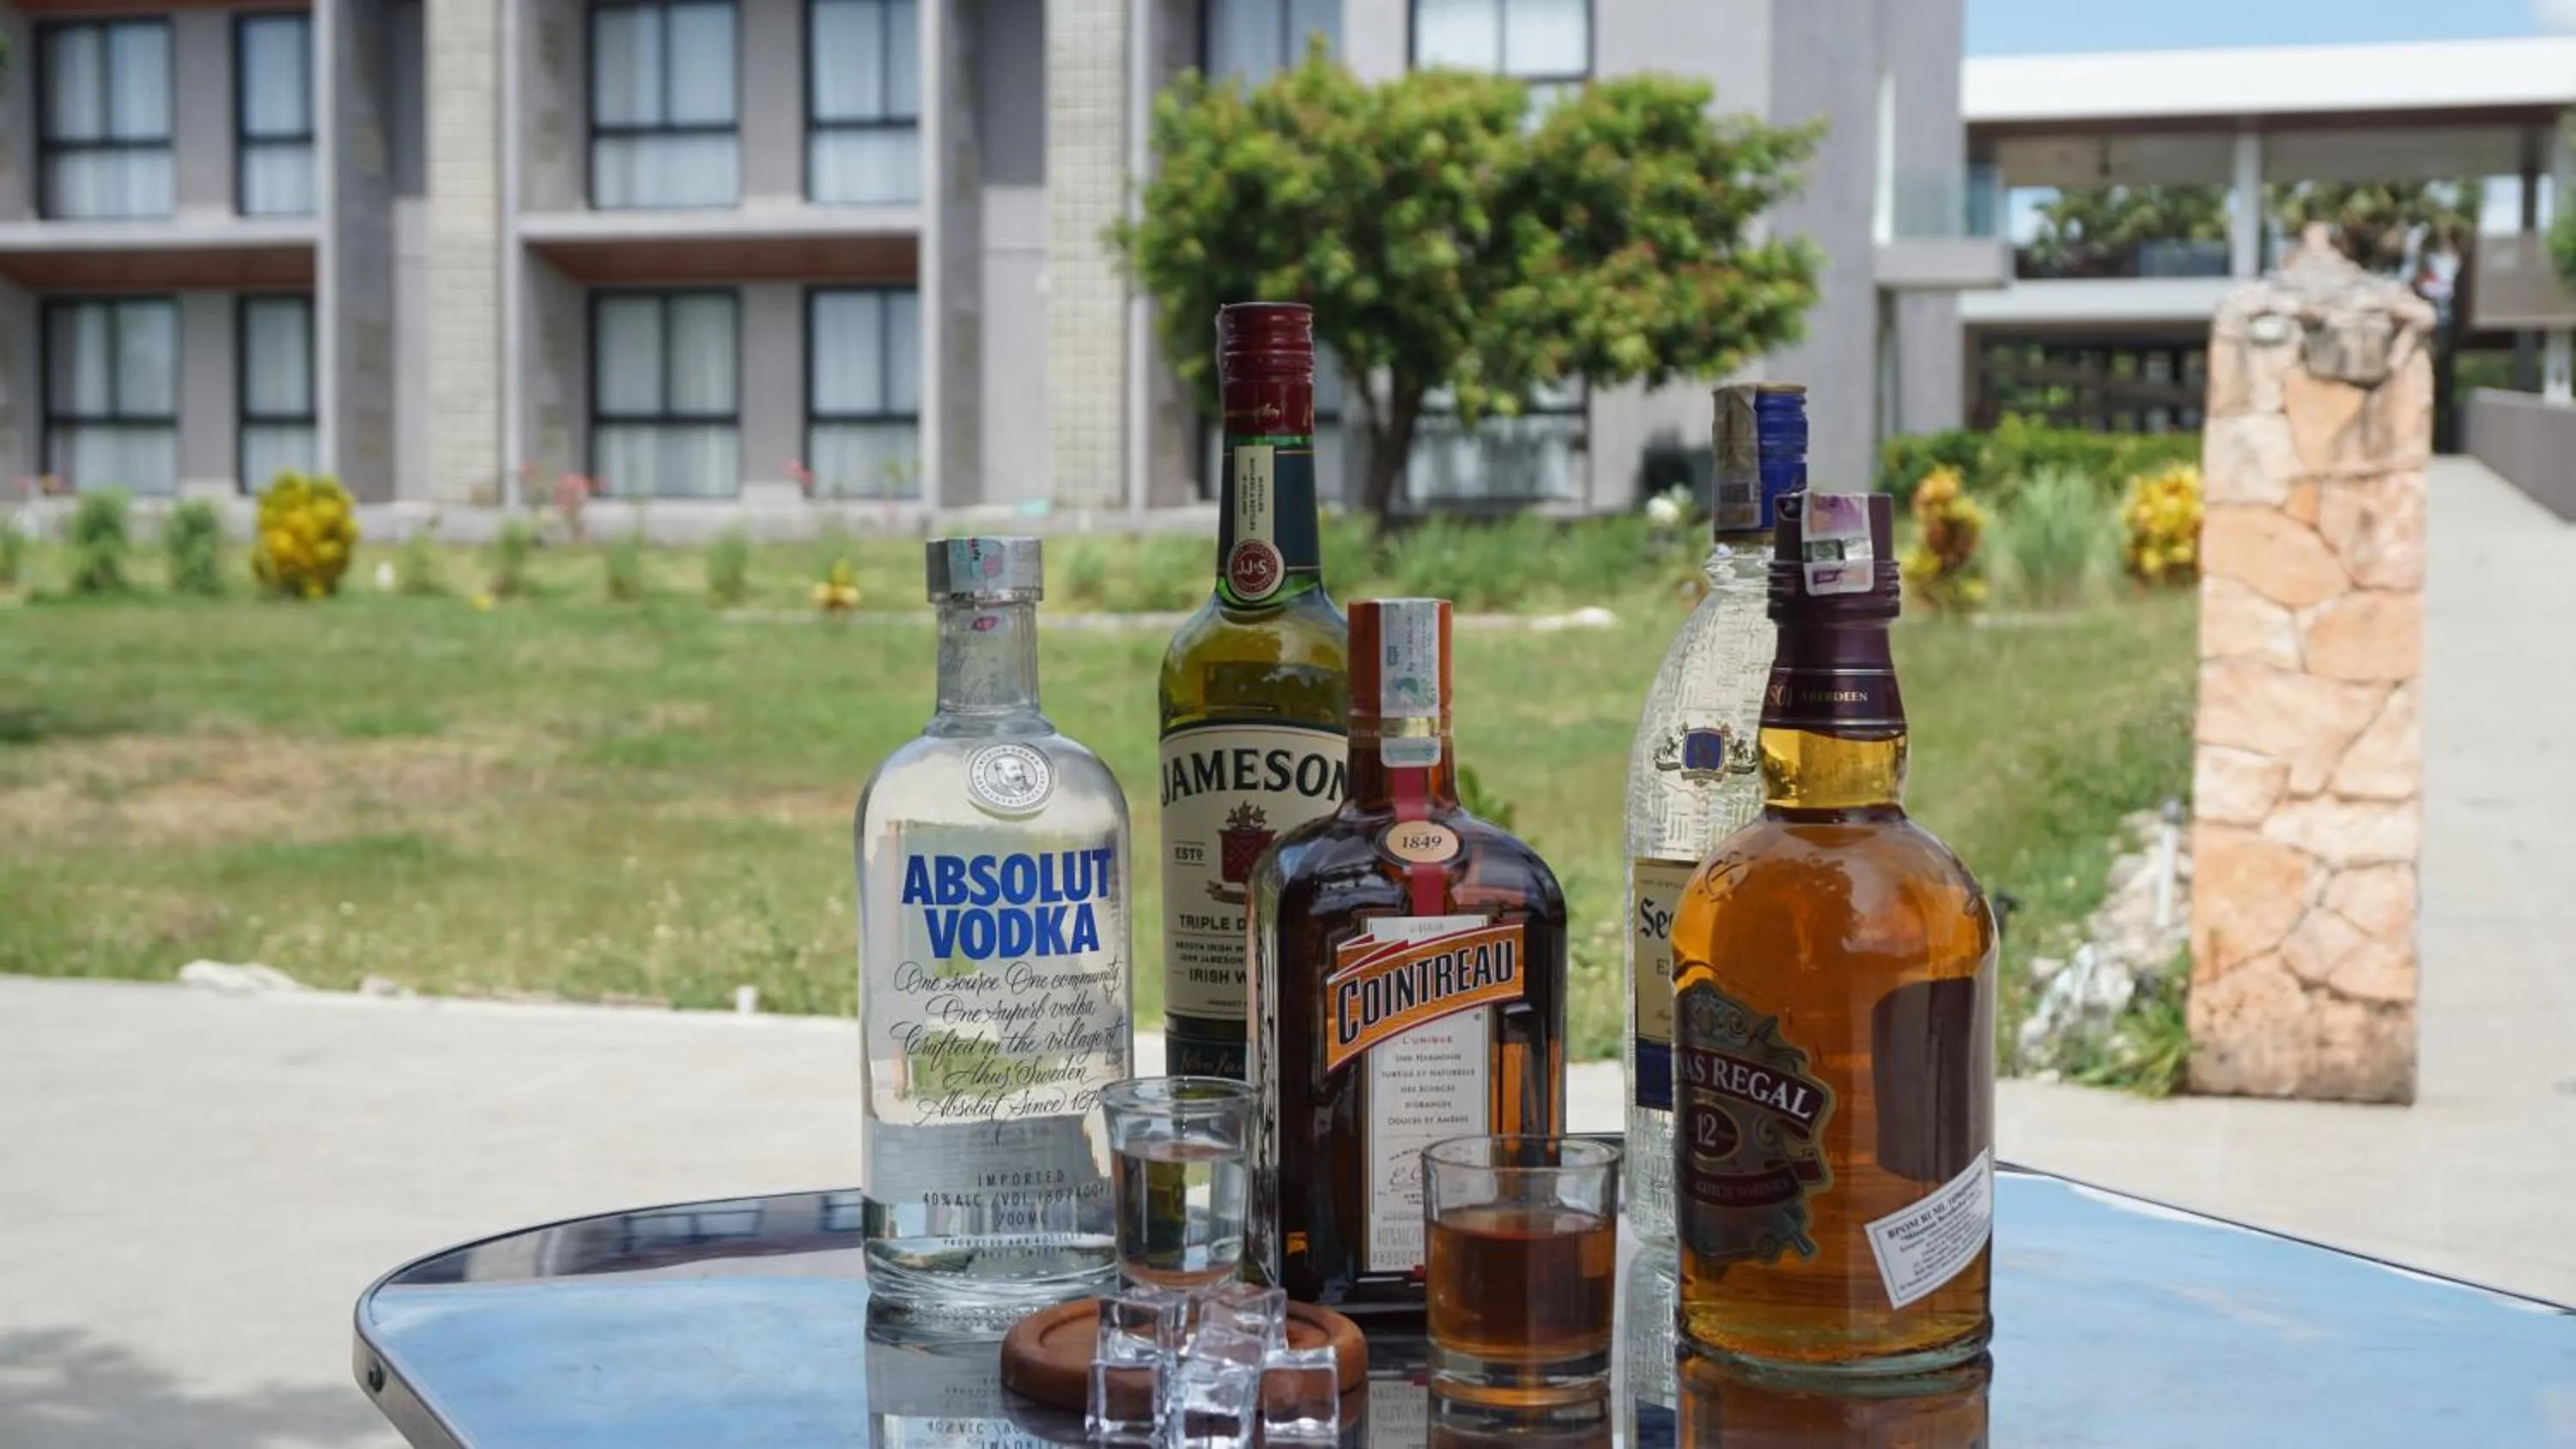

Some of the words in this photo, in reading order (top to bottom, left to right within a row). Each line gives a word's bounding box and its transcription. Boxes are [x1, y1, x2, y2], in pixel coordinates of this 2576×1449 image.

[1161, 748, 1348, 808] JAMESON
[1402, 835, 1443, 849] 1849
[902, 847, 1112, 906] ABSOLUT
[924, 903, 1100, 960] VODKA
[1179, 914, 1230, 931] TRIPLE
[894, 961, 941, 995] One
[1005, 961, 1048, 995] One
[1189, 967, 1230, 984] IRISH
[1338, 939, 1516, 1046] COINTREAU
[925, 993, 984, 1024] One
[1712, 1052, 1812, 1119] REGAL
[1697, 1112, 1717, 1148] 12
[977, 1168, 1065, 1187] IMPORTED
